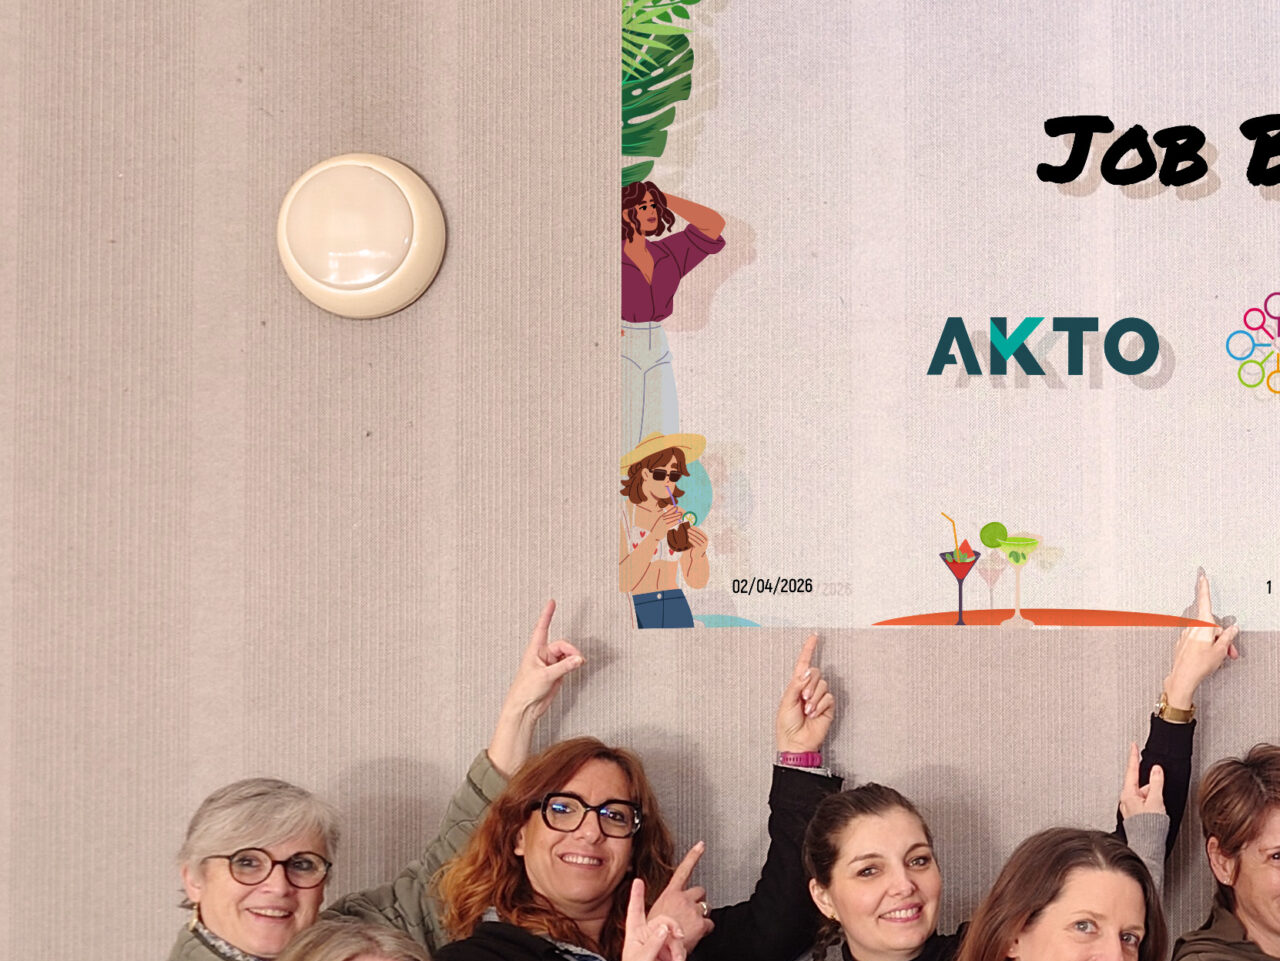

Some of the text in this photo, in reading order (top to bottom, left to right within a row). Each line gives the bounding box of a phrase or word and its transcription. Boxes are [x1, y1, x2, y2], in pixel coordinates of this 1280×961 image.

[926, 316, 1160, 376] AKTO
[731, 577, 813, 595] 02/04/2026
[1266, 580, 1272, 595] 1
